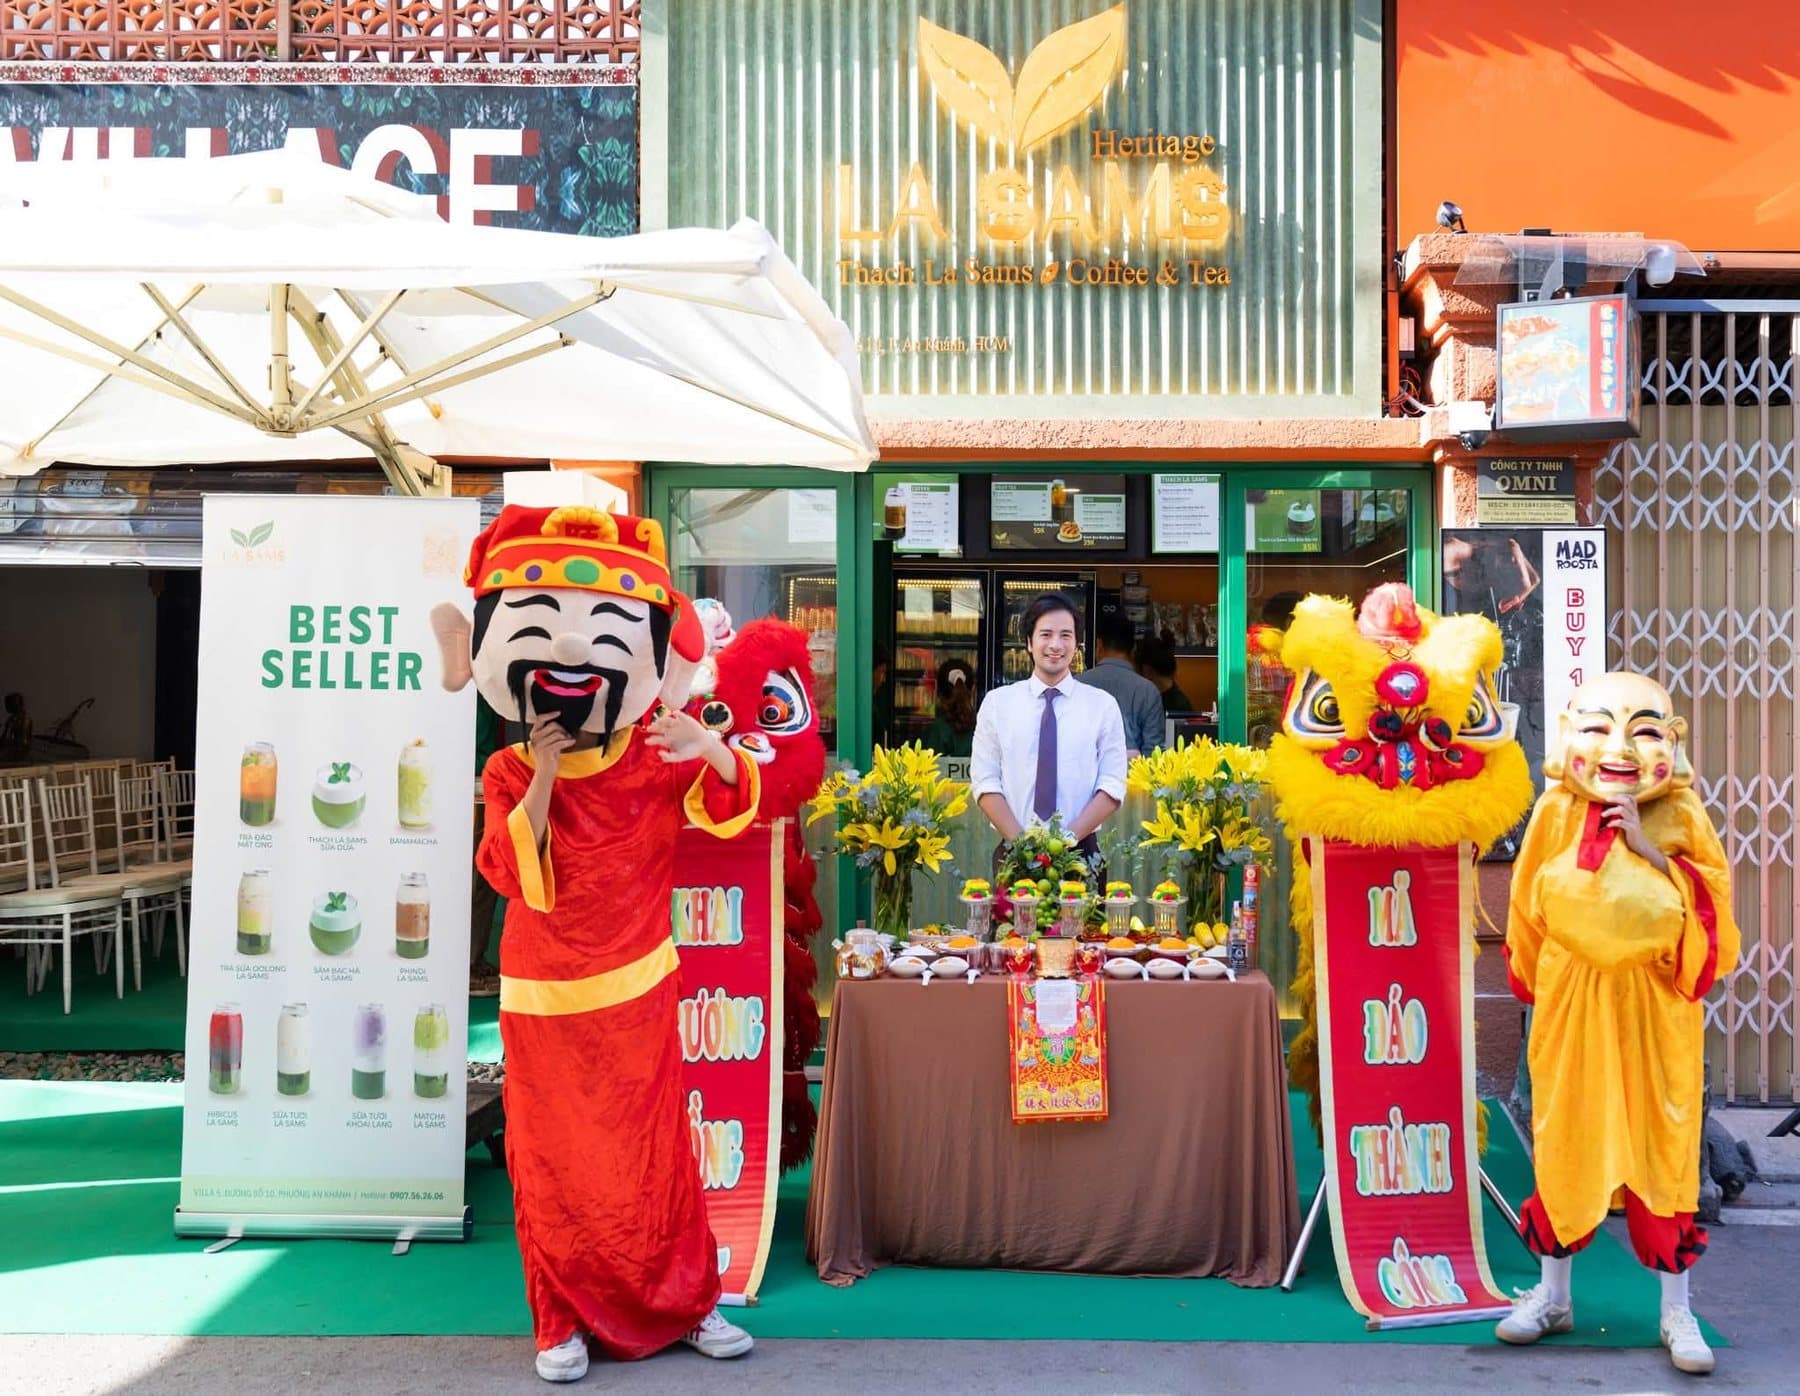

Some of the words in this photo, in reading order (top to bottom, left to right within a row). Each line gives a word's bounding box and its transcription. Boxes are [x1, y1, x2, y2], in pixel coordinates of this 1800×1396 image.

[1092, 129, 1215, 162] Heritage
[839, 162, 949, 241] LA
[978, 162, 1233, 242] SAMS
[924, 260, 957, 286] La
[964, 259, 1034, 286] Sams
[1066, 258, 1149, 286] Coffee
[1155, 261, 1181, 286] &
[1187, 260, 1231, 286] Tea
[1490, 459, 1517, 471] CÔNG
[1520, 461, 1533, 471] TY
[1536, 461, 1563, 471] TNHH
[1495, 475, 1557, 491] OMNI
[1556, 540, 1597, 560] MAD
[1556, 559, 1598, 570] ROOSTA
[289, 605, 399, 645] BEST
[1565, 588, 1586, 657] BUY
[261, 649, 423, 691] SELLER
[671, 886, 745, 947] KHAI
[678, 986, 765, 1062] ƯƠNG
[1362, 982, 1428, 1065] ĐÁO
[1350, 1105, 1454, 1196] THÀNH
[1378, 1236, 1469, 1309] CÔNG
